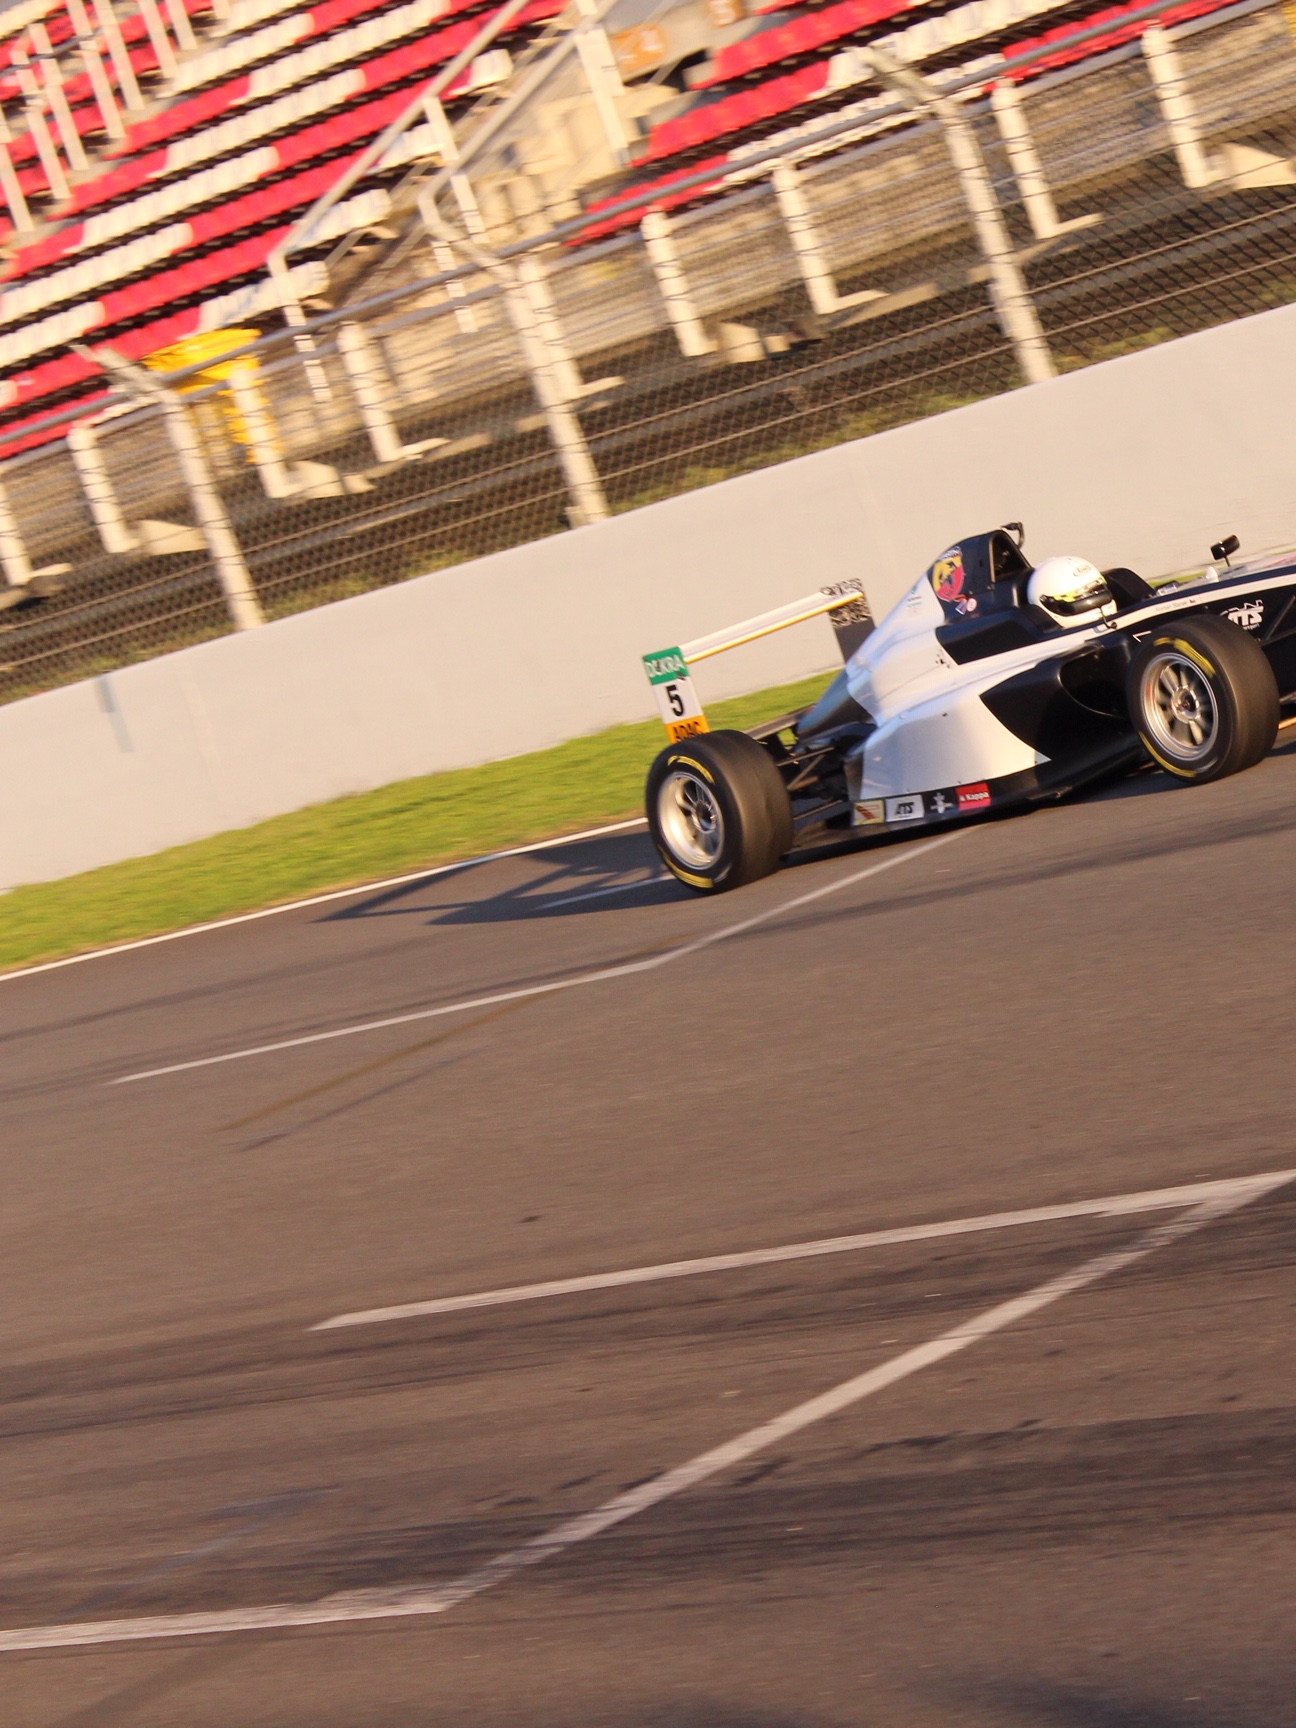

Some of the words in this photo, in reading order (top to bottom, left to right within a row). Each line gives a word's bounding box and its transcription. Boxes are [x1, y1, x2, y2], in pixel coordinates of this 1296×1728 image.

[644, 654, 687, 678] DEKRA
[665, 684, 685, 717] 5
[966, 791, 989, 801] Kappa
